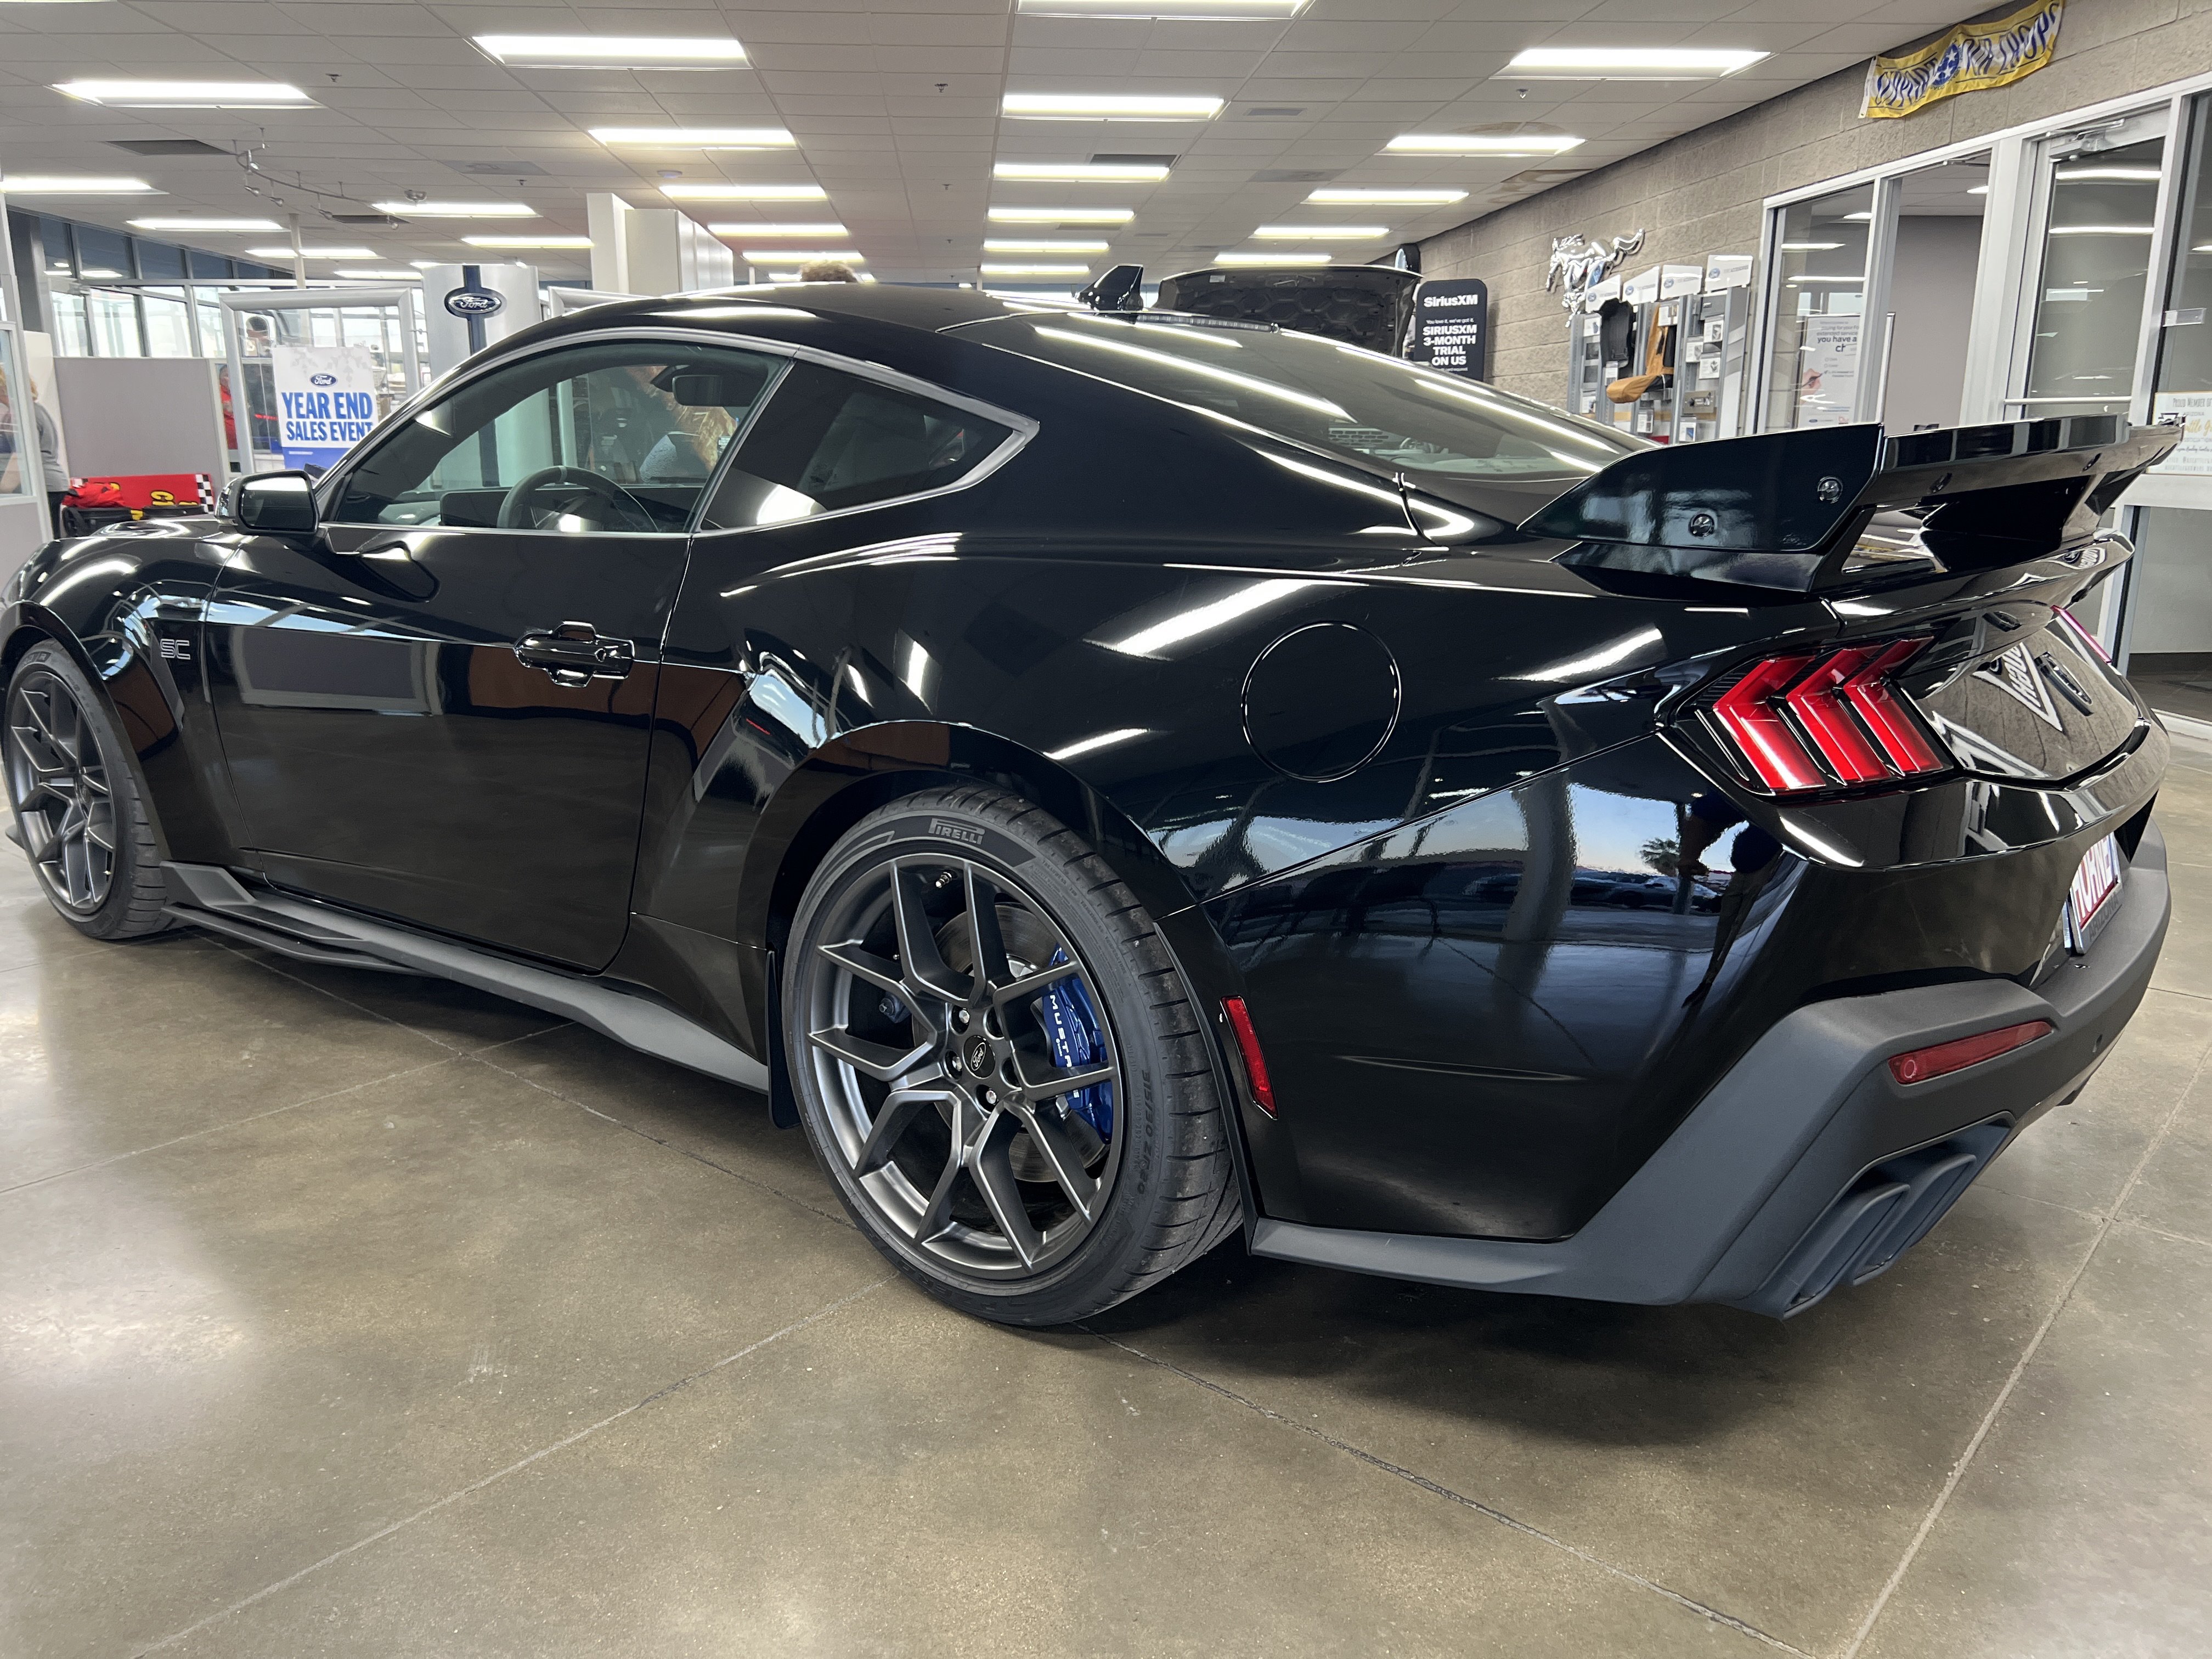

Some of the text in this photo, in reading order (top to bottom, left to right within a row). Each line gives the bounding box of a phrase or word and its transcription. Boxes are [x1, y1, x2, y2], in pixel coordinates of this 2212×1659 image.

[459, 296, 488, 308] Ford
[1423, 294, 1478, 308] SiriusXM
[1422, 324, 1478, 336] SIRIUSXM
[1423, 335, 1476, 346] 3-MONTH
[1432, 345, 1466, 356] TRIAL
[1431, 356, 1466, 366] ON US
[314, 375, 332, 386] Ford
[281, 392, 374, 420] YEAR END
[286, 421, 374, 441] SALES EVENT
[160, 638, 191, 660] SC
[928, 818, 985, 845] PIRELLI
[973, 1047, 984, 1068] Ford
